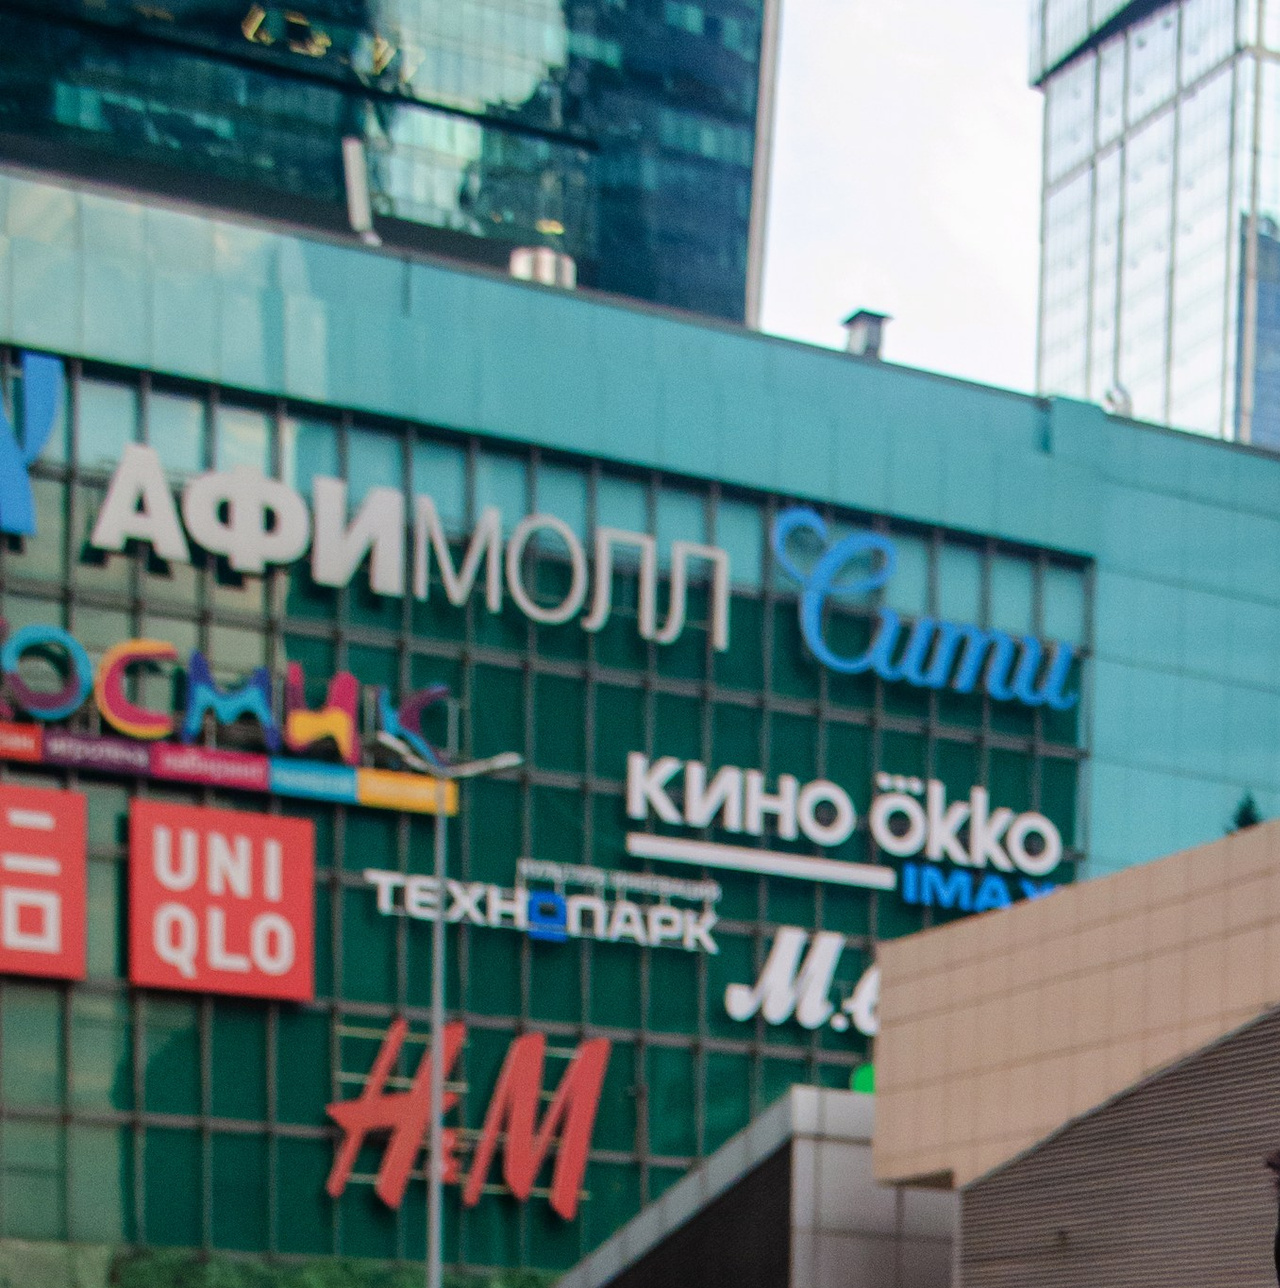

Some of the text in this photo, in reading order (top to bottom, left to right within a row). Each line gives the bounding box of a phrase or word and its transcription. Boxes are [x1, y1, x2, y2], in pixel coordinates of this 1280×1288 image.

[93, 443, 729, 652] АФИМОЛЛ
[626, 751, 857, 847] КИНО
[152, 824, 283, 902] UNI
[152, 904, 296, 979] QLO
[364, 868, 719, 955] ТЕХНОПАРК
